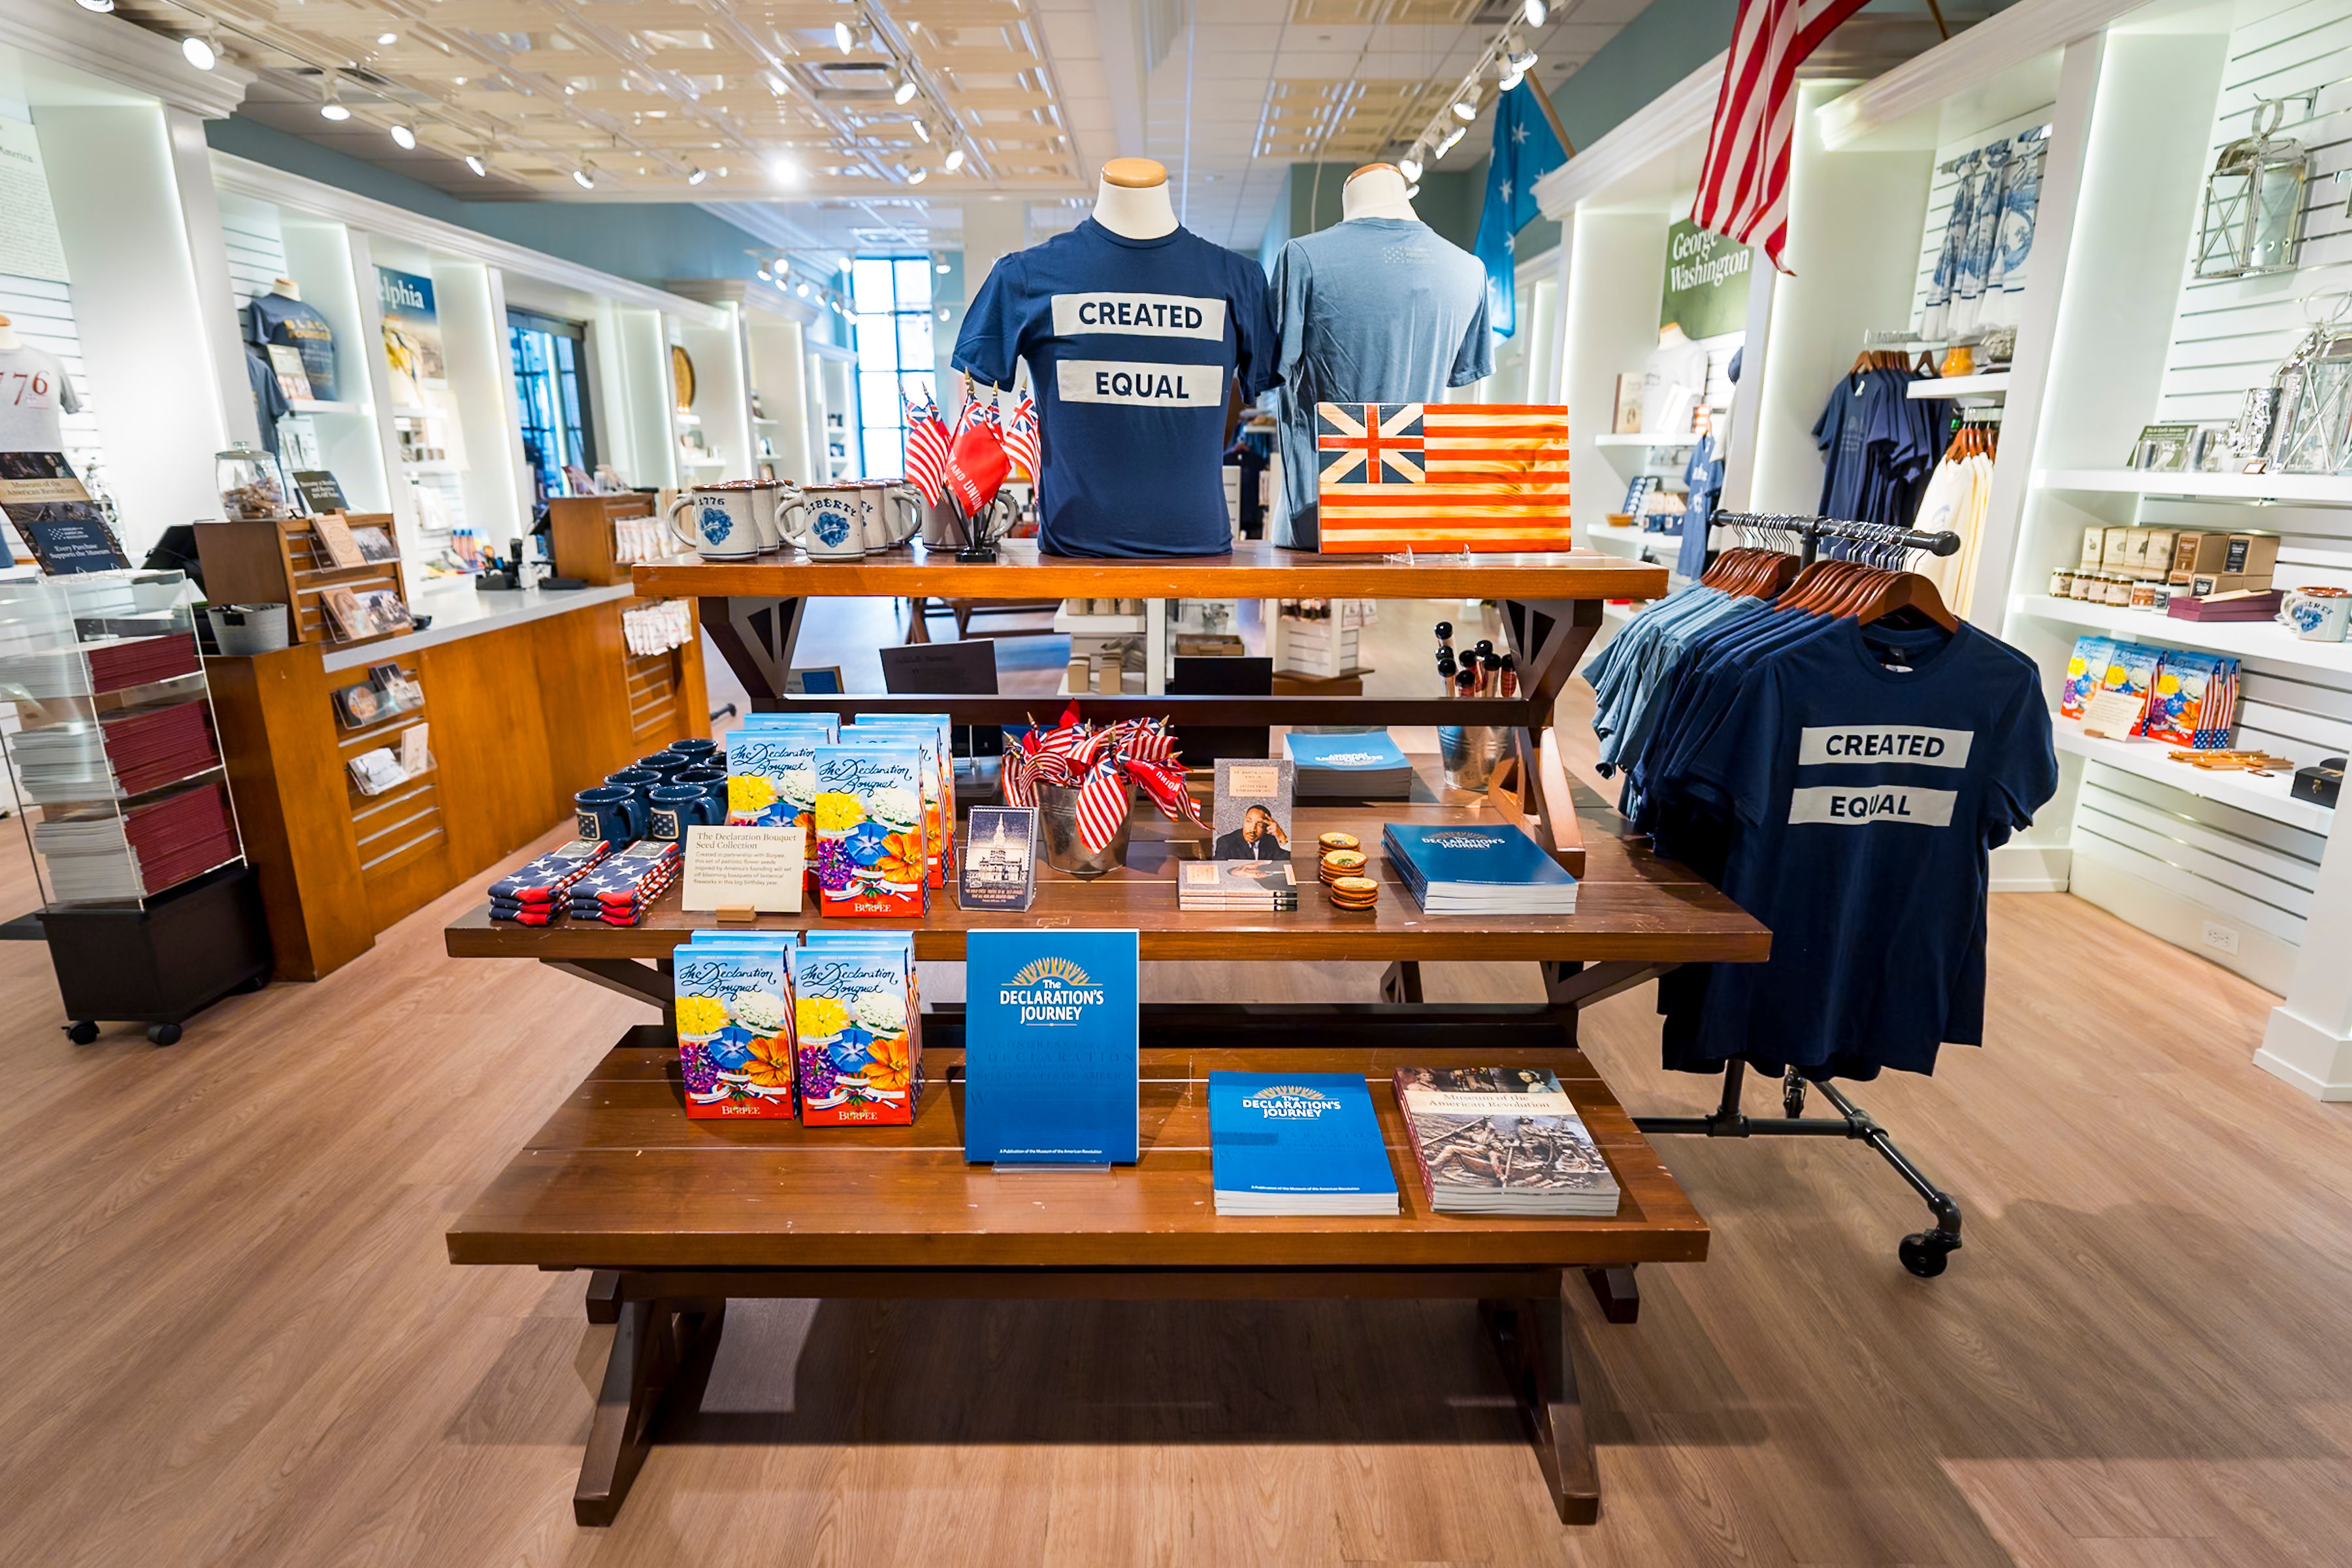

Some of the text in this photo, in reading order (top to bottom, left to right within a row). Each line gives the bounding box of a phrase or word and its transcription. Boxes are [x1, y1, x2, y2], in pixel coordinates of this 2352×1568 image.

[1671, 248, 1750, 293] Washington
[1079, 302, 1203, 329] CREATED
[0, 370, 50, 406] 76
[1096, 371, 1189, 400] EQUAL
[950, 465, 966, 482] AND
[963, 480, 983, 511] UNION
[699, 497, 726, 506] 1776
[805, 497, 857, 517] LIBERTY
[731, 743, 816, 766] The Declaration
[1825, 734, 1945, 758] CREATED
[740, 759, 808, 780] Bouquet
[819, 759, 912, 781] The Declaration
[828, 775, 899, 798] Bouquet
[1830, 794, 1911, 818] EQUAL
[715, 832, 761, 841] Declaration
[763, 834, 796, 843] Bouquet
[855, 902, 891, 912] BURPEE
[679, 962, 777, 986] The Declaration
[800, 962, 898, 987] The Declaration
[1042, 979, 1062, 988] The
[689, 979, 763, 1002] Bouquet
[809, 979, 883, 1003] Bouquet
[1000, 989, 1104, 1005] DECLARATION'S
[1020, 1006, 1083, 1024] JOURNEY
[988, 1052, 1134, 1062] DECLARATION
[721, 1105, 760, 1115] BURPEE
[839, 1111, 877, 1120] BURPEE
[1242, 1099, 1341, 1110] DECLARATION'S
[1264, 1108, 1322, 1119] JOURNEY
